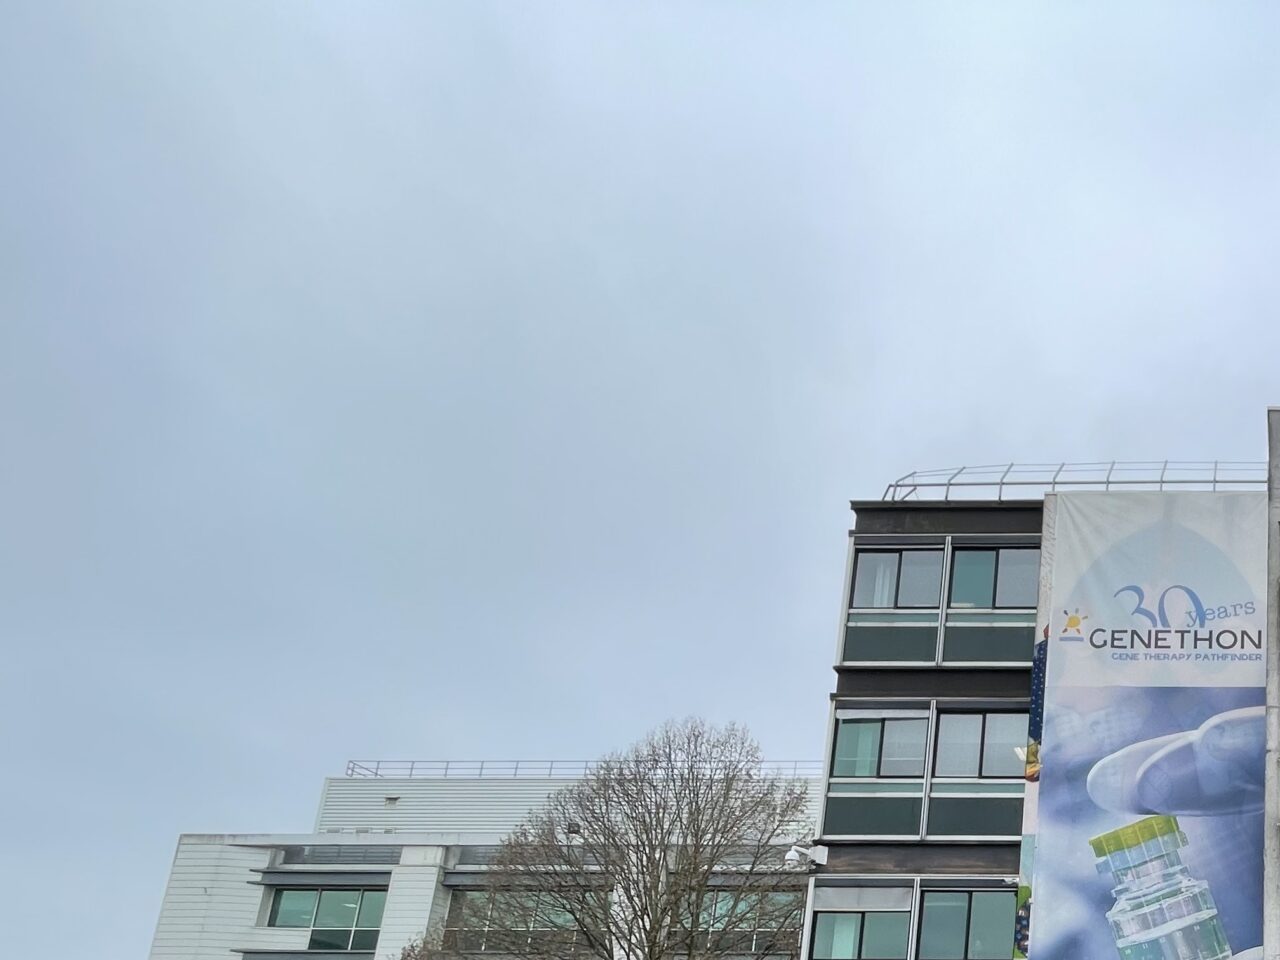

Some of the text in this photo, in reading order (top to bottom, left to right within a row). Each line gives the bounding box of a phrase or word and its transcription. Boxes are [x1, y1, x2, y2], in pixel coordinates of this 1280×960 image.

[1113, 584, 1257, 629] 30 years
[1089, 628, 1262, 650] GENETHON
[1111, 652, 1263, 662] GENE THERAPY PATHFINDER
